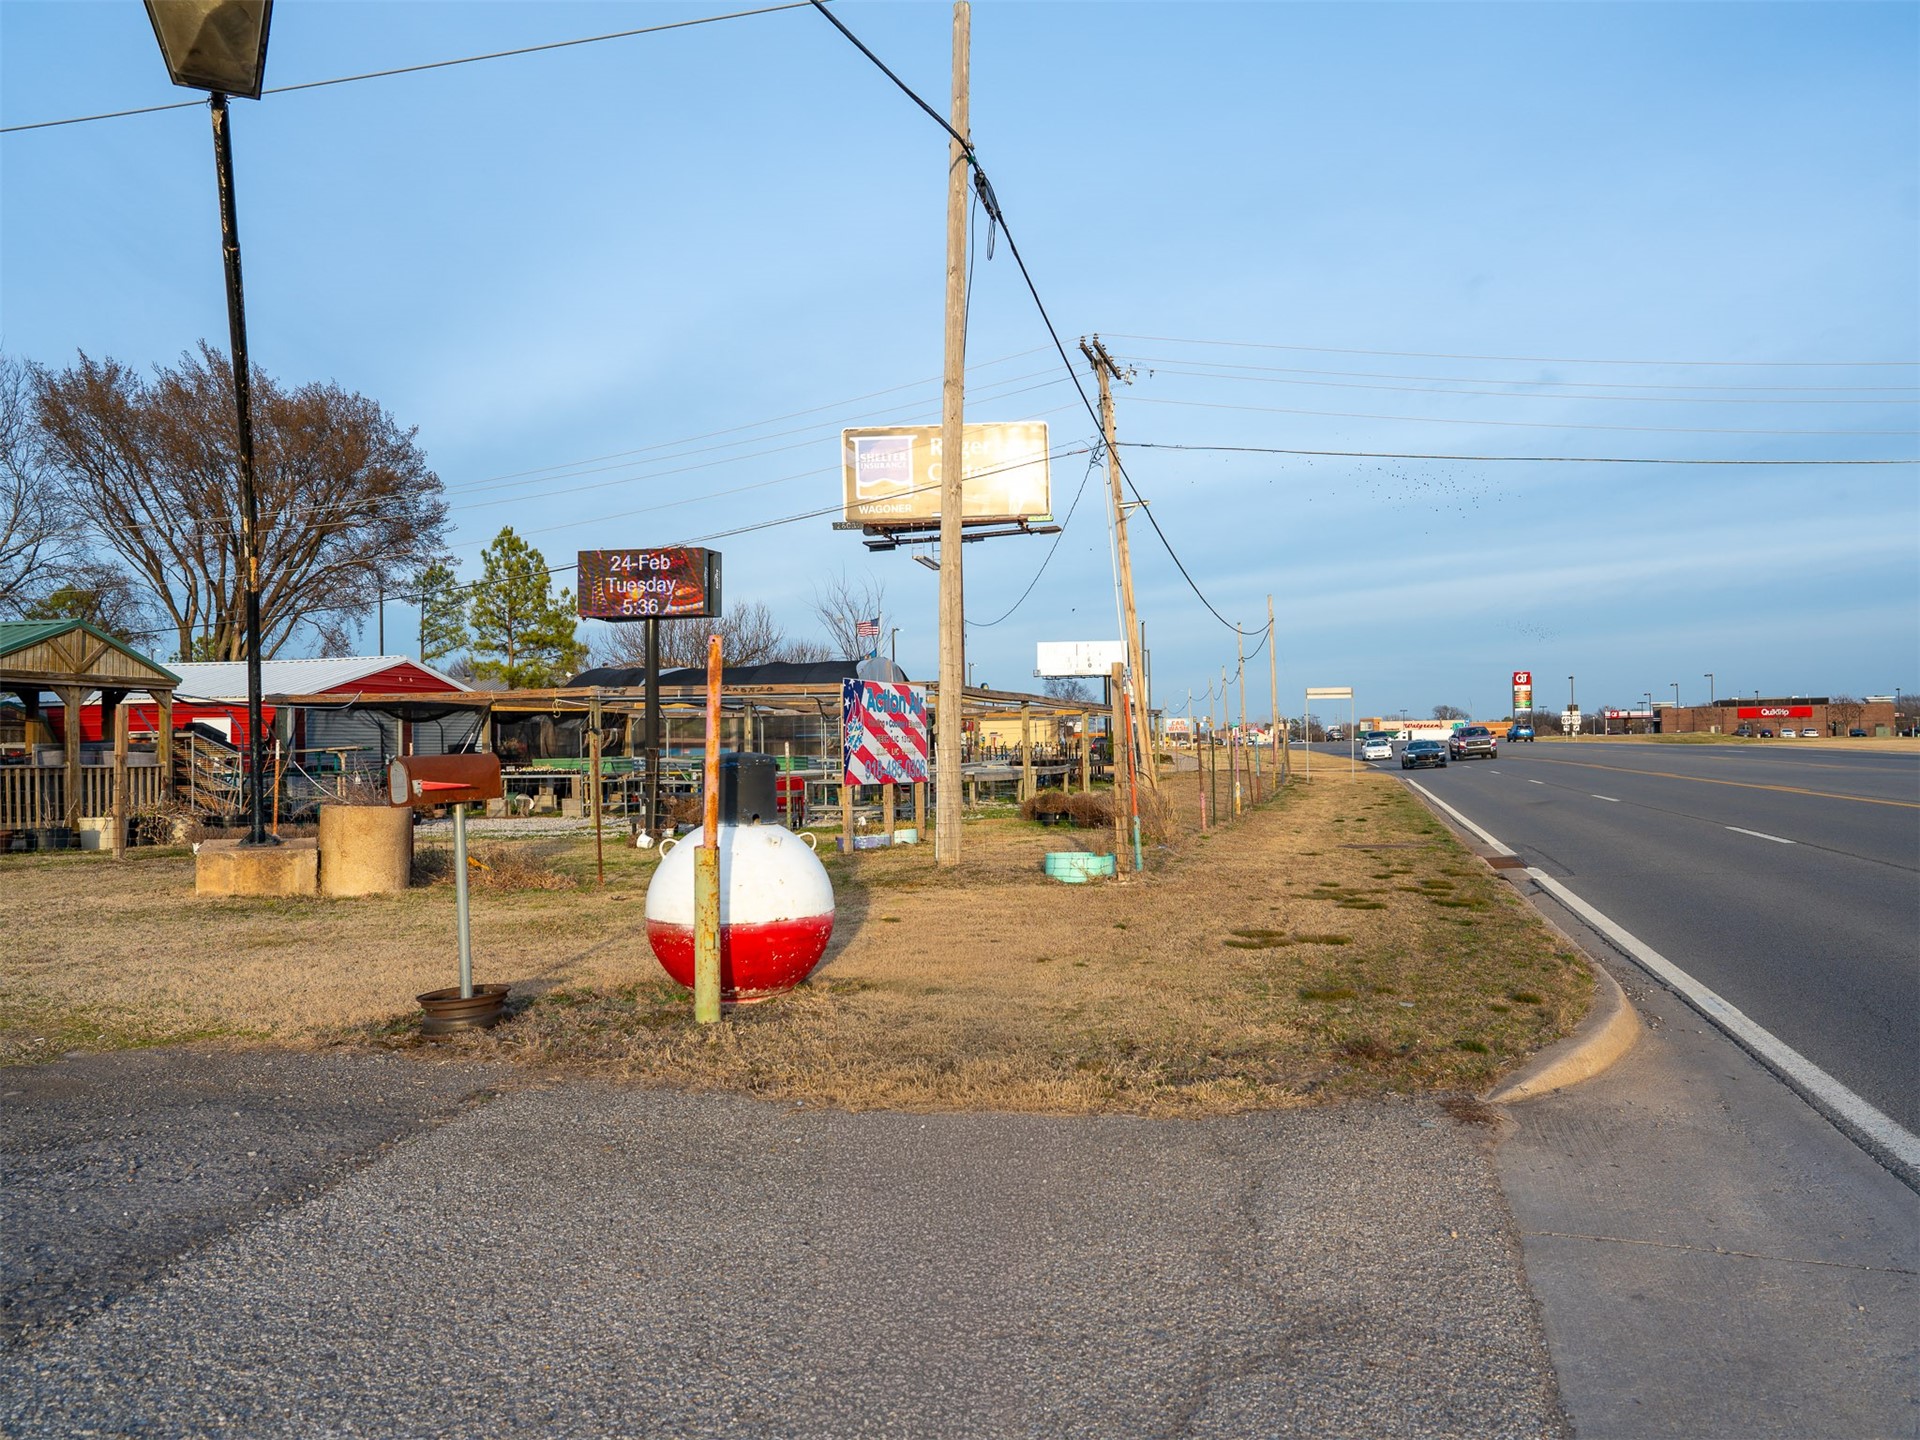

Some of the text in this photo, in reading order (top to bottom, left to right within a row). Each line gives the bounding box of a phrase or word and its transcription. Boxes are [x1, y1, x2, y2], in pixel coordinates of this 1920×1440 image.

[930, 438, 990, 459] Rger
[860, 453, 907, 462] SHELTER
[860, 462, 907, 470] INSURANCE
[858, 504, 912, 514] WAGONER
[610, 554, 670, 571] 24-Feb
[605, 576, 677, 595] Tuesday
[623, 598, 658, 615] 5:36
[1515, 674, 1528, 683] QT
[867, 687, 924, 715] Action Air
[1761, 708, 1789, 717] QuikTrip
[865, 759, 926, 779] 918-485-0306
